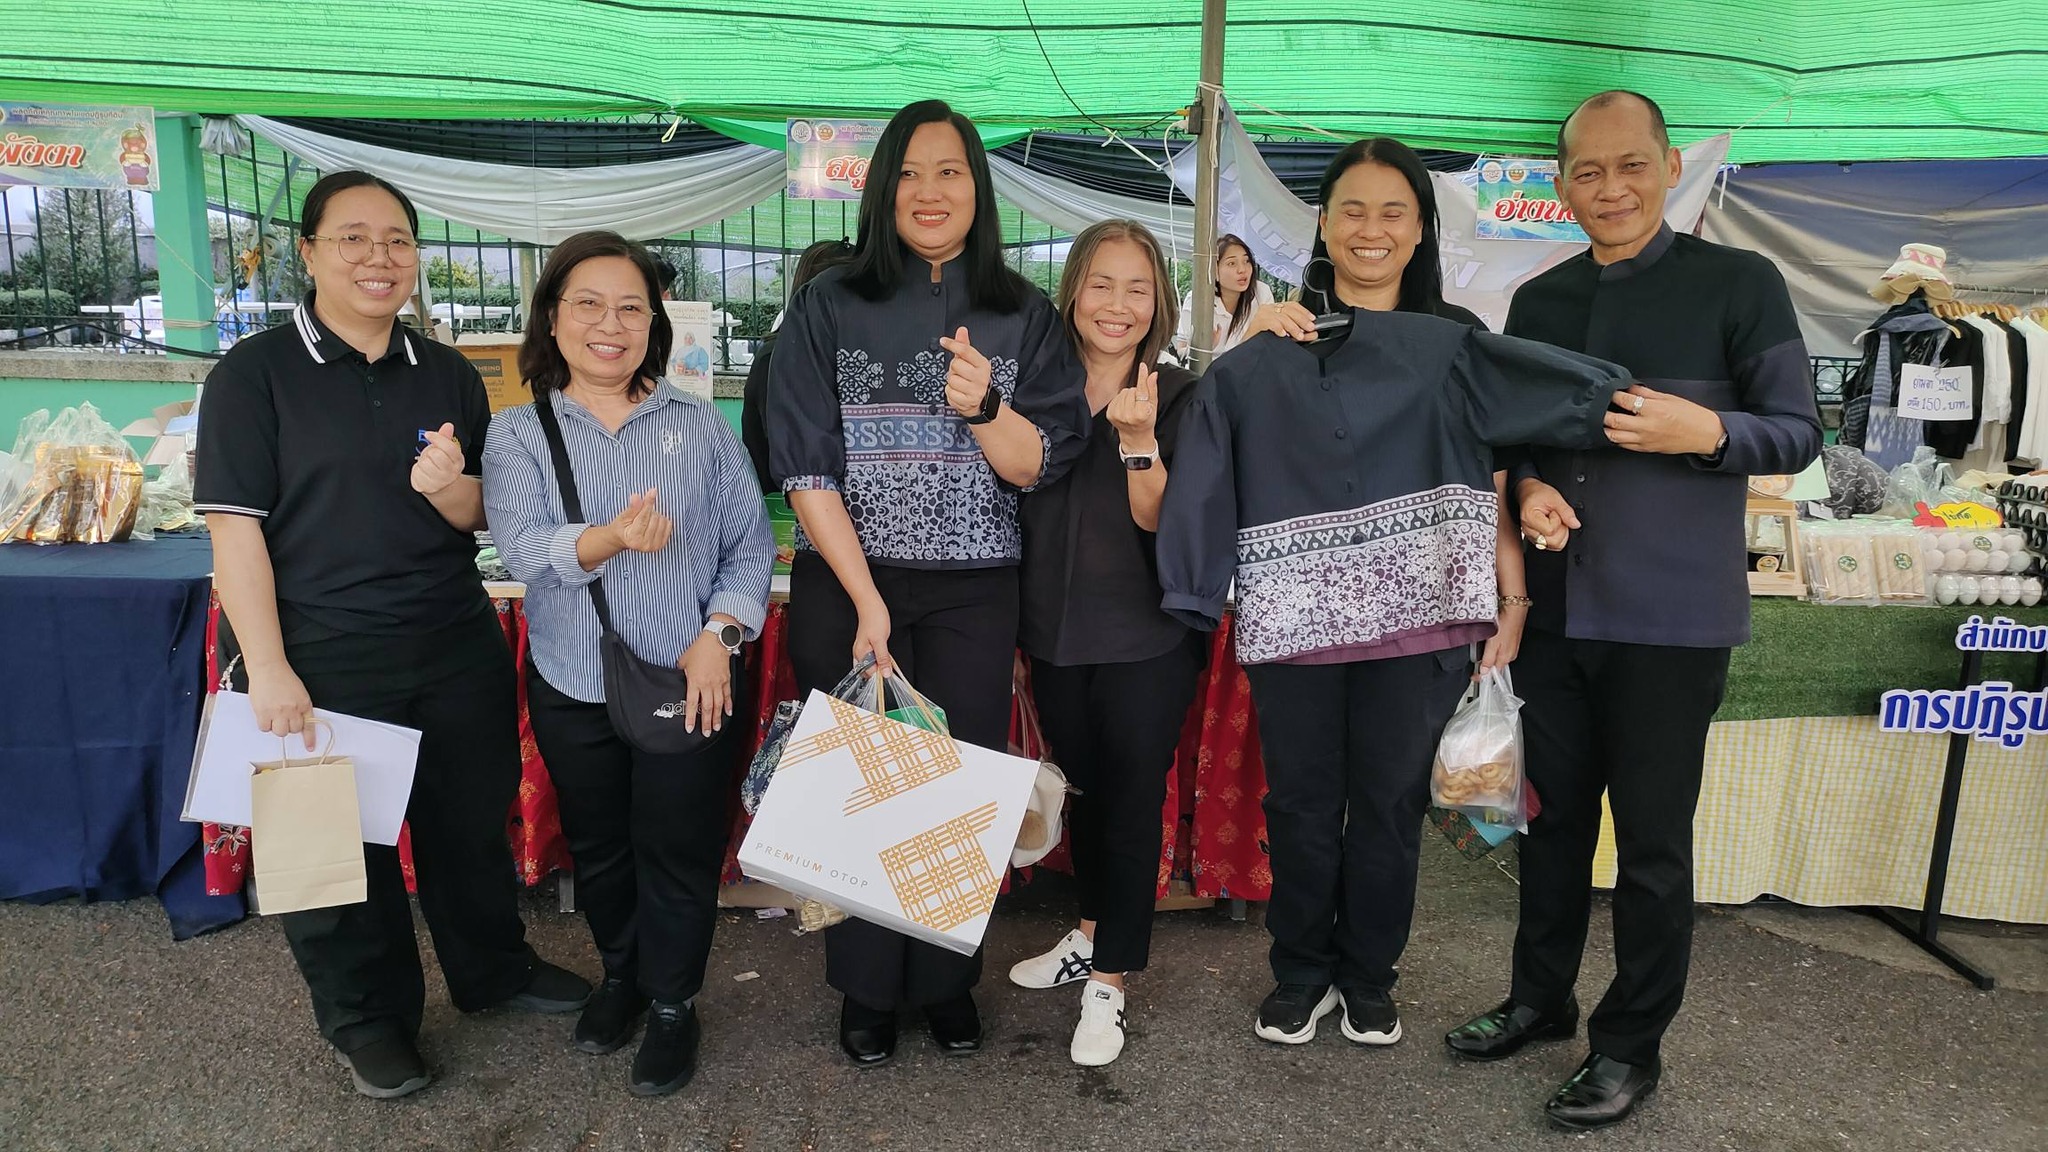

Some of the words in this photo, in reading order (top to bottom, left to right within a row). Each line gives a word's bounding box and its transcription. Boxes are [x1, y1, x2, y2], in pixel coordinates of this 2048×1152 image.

[825, 155, 870, 189] สตู
[754, 842, 823, 873] PREMIUM
[829, 869, 869, 888] OTOP
